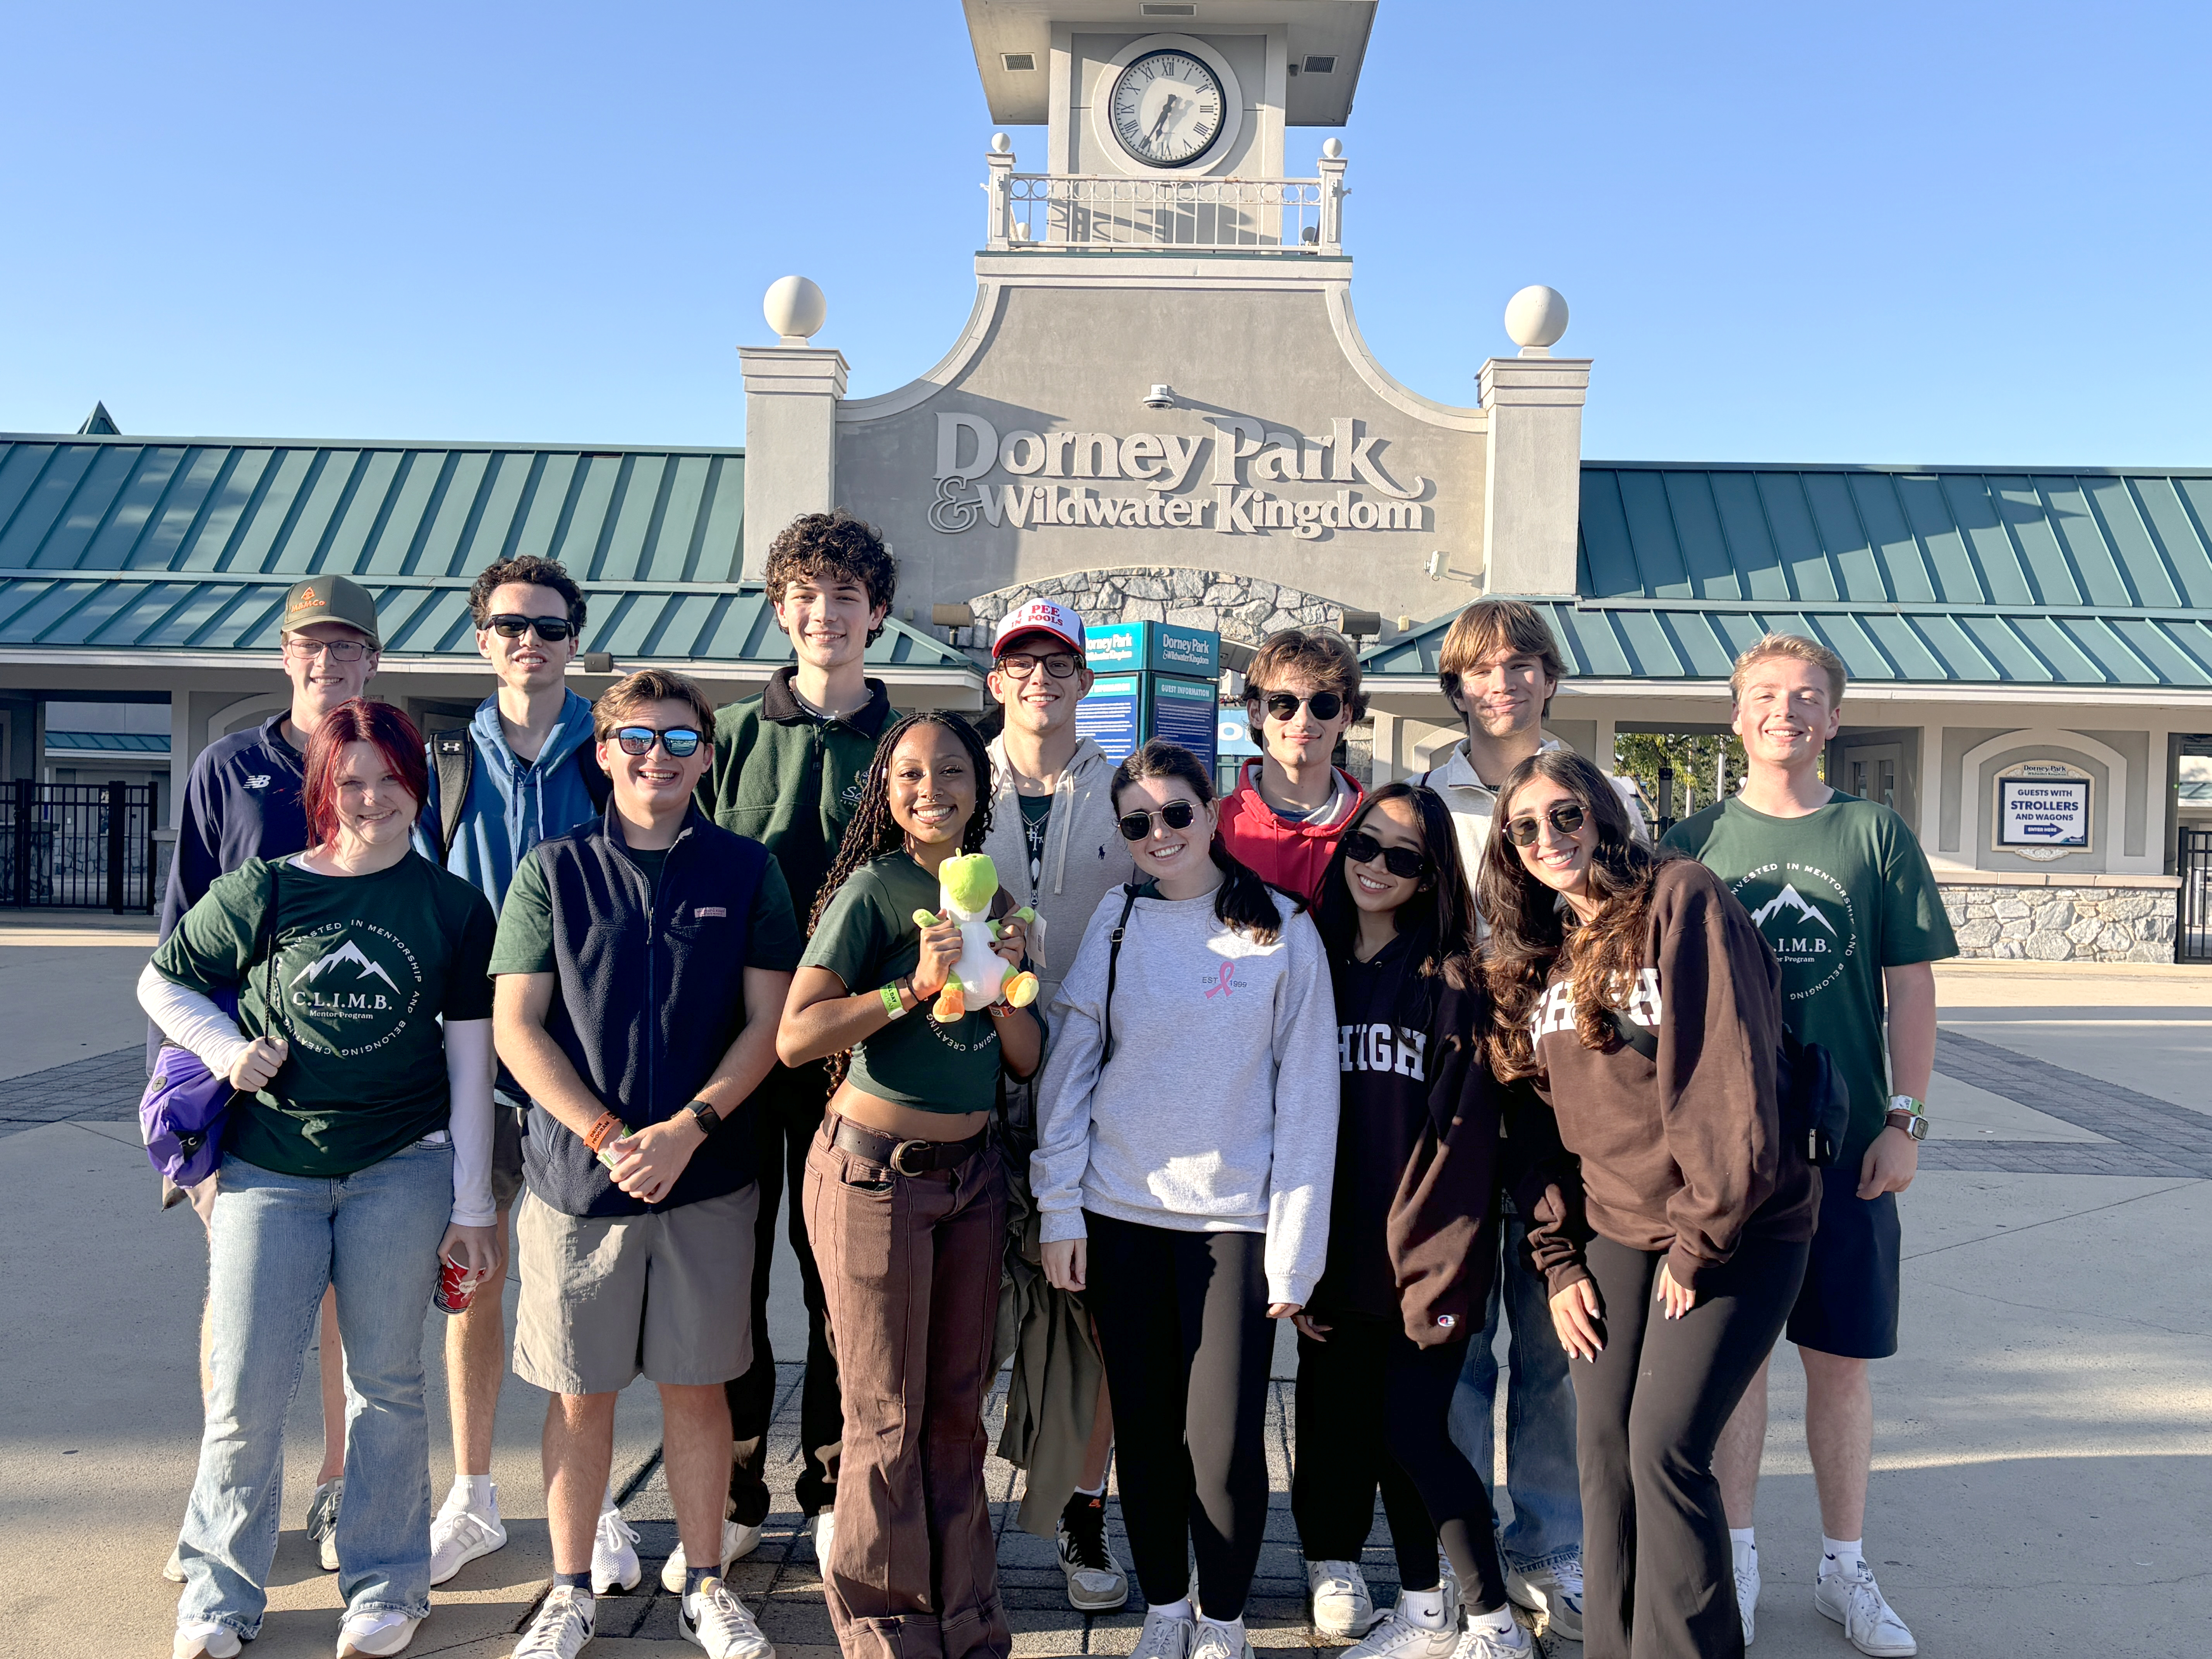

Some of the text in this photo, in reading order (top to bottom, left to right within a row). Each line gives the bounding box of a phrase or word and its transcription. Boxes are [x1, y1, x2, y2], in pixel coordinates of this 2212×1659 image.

[932, 412, 1425, 499] Dorney Park
[1215, 485, 1422, 540] Kingdom
[1011, 614, 1063, 628] IN POOLS
[1017, 605, 1060, 618] I PEE
[1163, 633, 1209, 654] Dorney Park
[1161, 684, 1209, 697] GUEST INFORMATION
[2011, 800, 2079, 811] STROLLERS
[1731, 863, 1778, 896] NVESTED
[351, 919, 364, 928] IN
[368, 924, 422, 983] MENTORSHIP
[1845, 933, 1856, 956] AND
[1790, 963, 1844, 1000] BELONGING
[292, 991, 393, 1010] C.L.I.M.B.
[407, 991, 420, 1014] AND
[309, 1010, 374, 1020] Mentor Program
[341, 1020, 407, 1056] BELONGING
[926, 1013, 997, 1052] CREATING NGING
